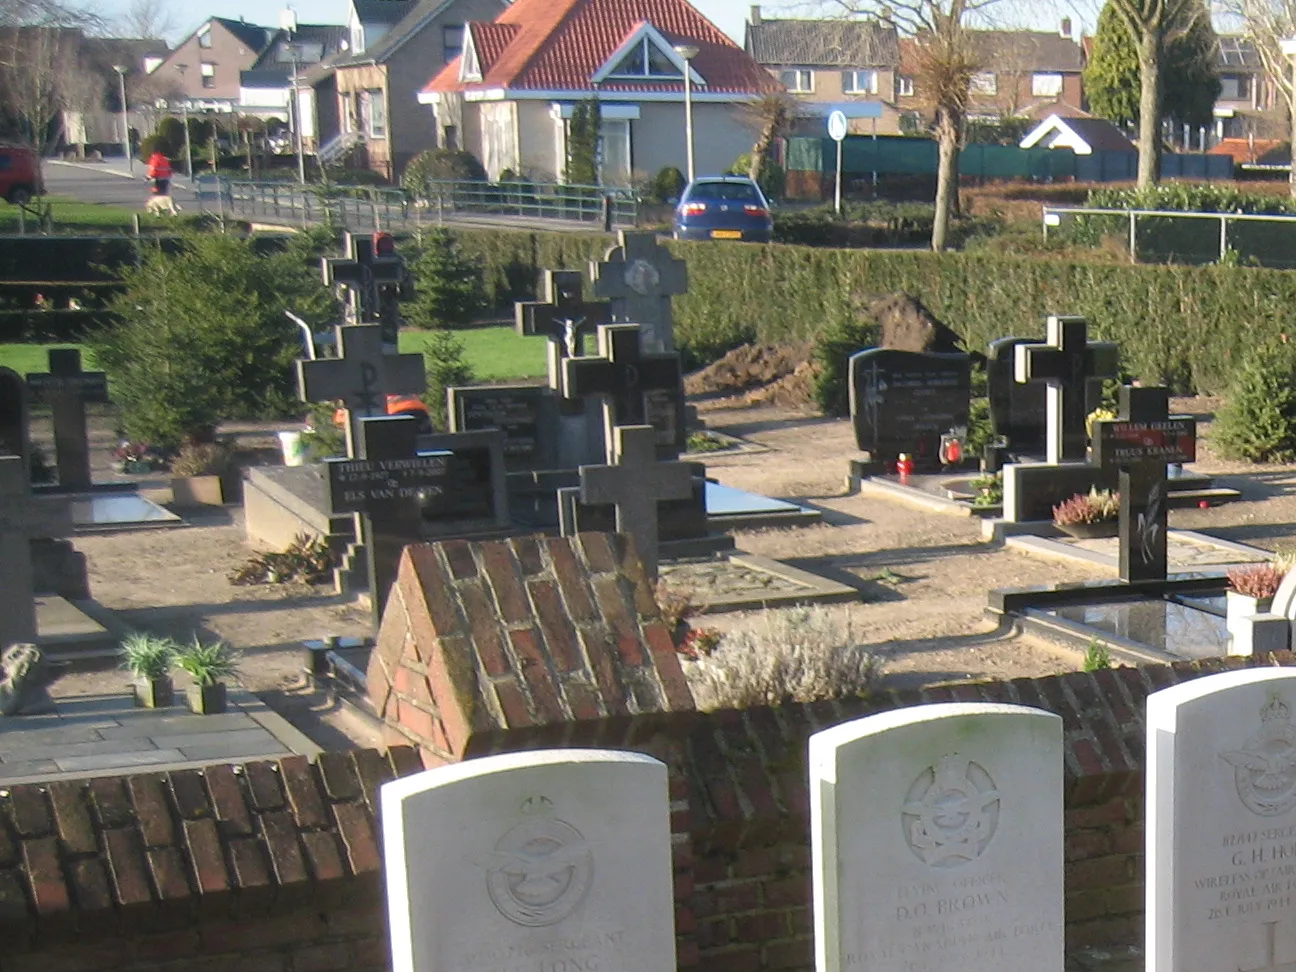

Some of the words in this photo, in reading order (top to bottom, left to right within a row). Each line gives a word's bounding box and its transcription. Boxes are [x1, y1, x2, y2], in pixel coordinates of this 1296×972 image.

[370, 489, 395, 499] VAN
[1231, 851, 1246, 866] G.
[1220, 886, 1257, 901] ROYAL
[1262, 883, 1283, 896] AIR
[937, 890, 1008, 915] BROWN
